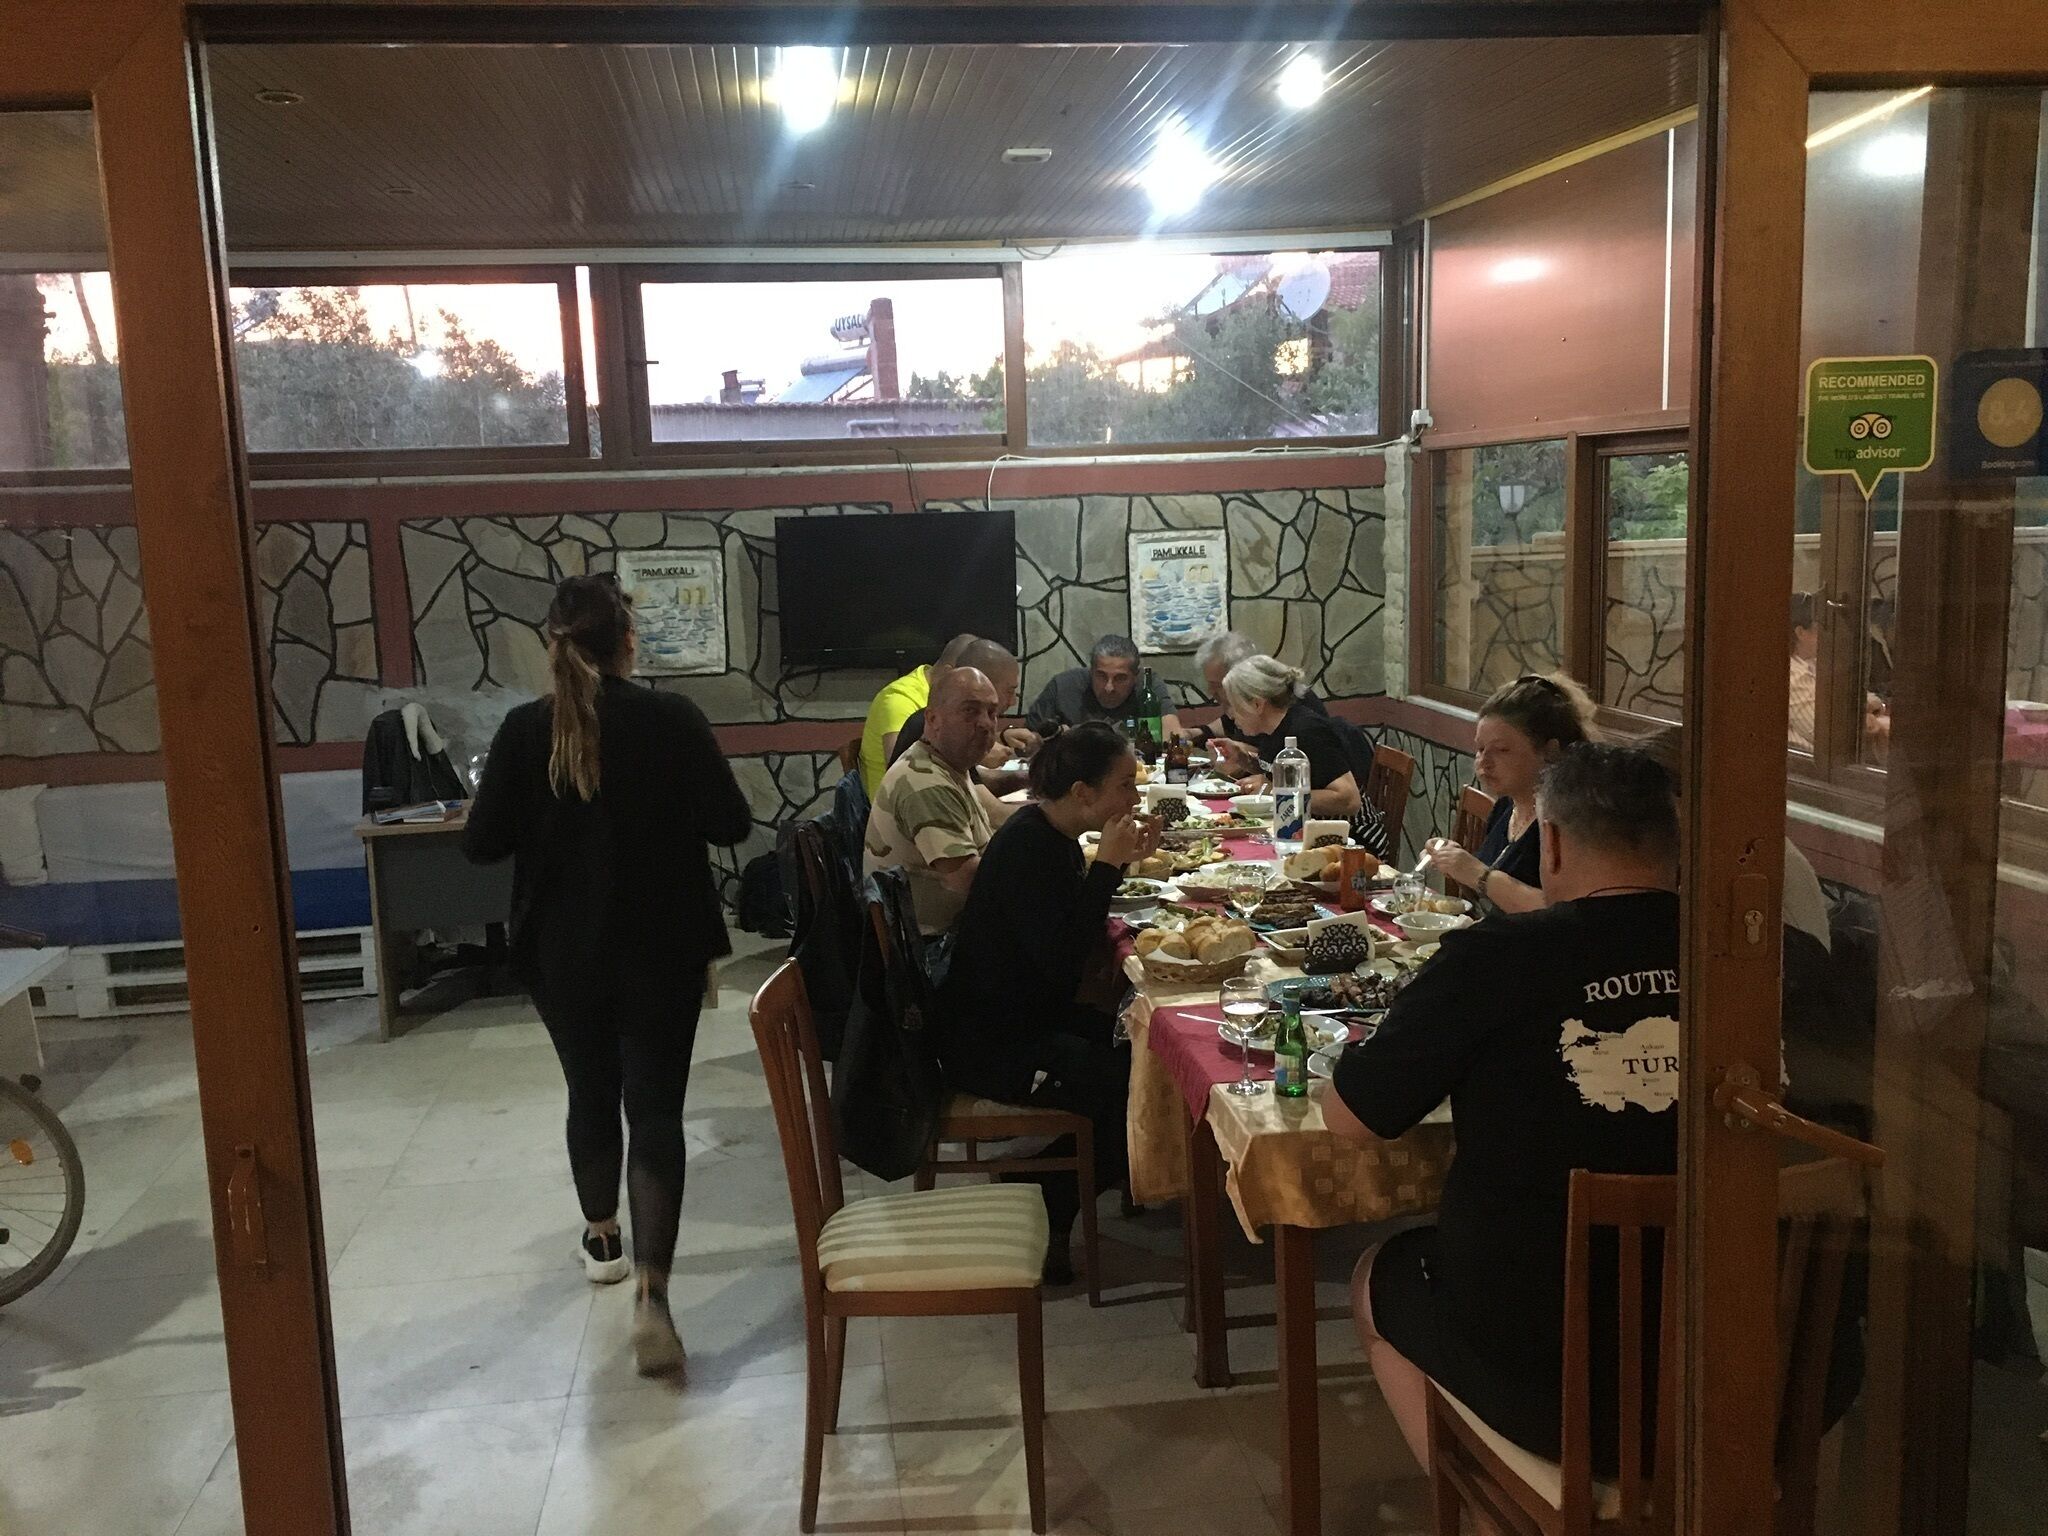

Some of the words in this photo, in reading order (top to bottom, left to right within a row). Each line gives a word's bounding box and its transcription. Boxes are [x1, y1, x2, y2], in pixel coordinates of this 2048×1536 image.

[1818, 374, 1926, 389] RECOMMENDED
[1834, 445, 1902, 462] tripadvisor
[1152, 545, 1206, 558] PAMUKKALE
[1583, 969, 1680, 1003] ROUTE
[1622, 1056, 1680, 1075] TUR
